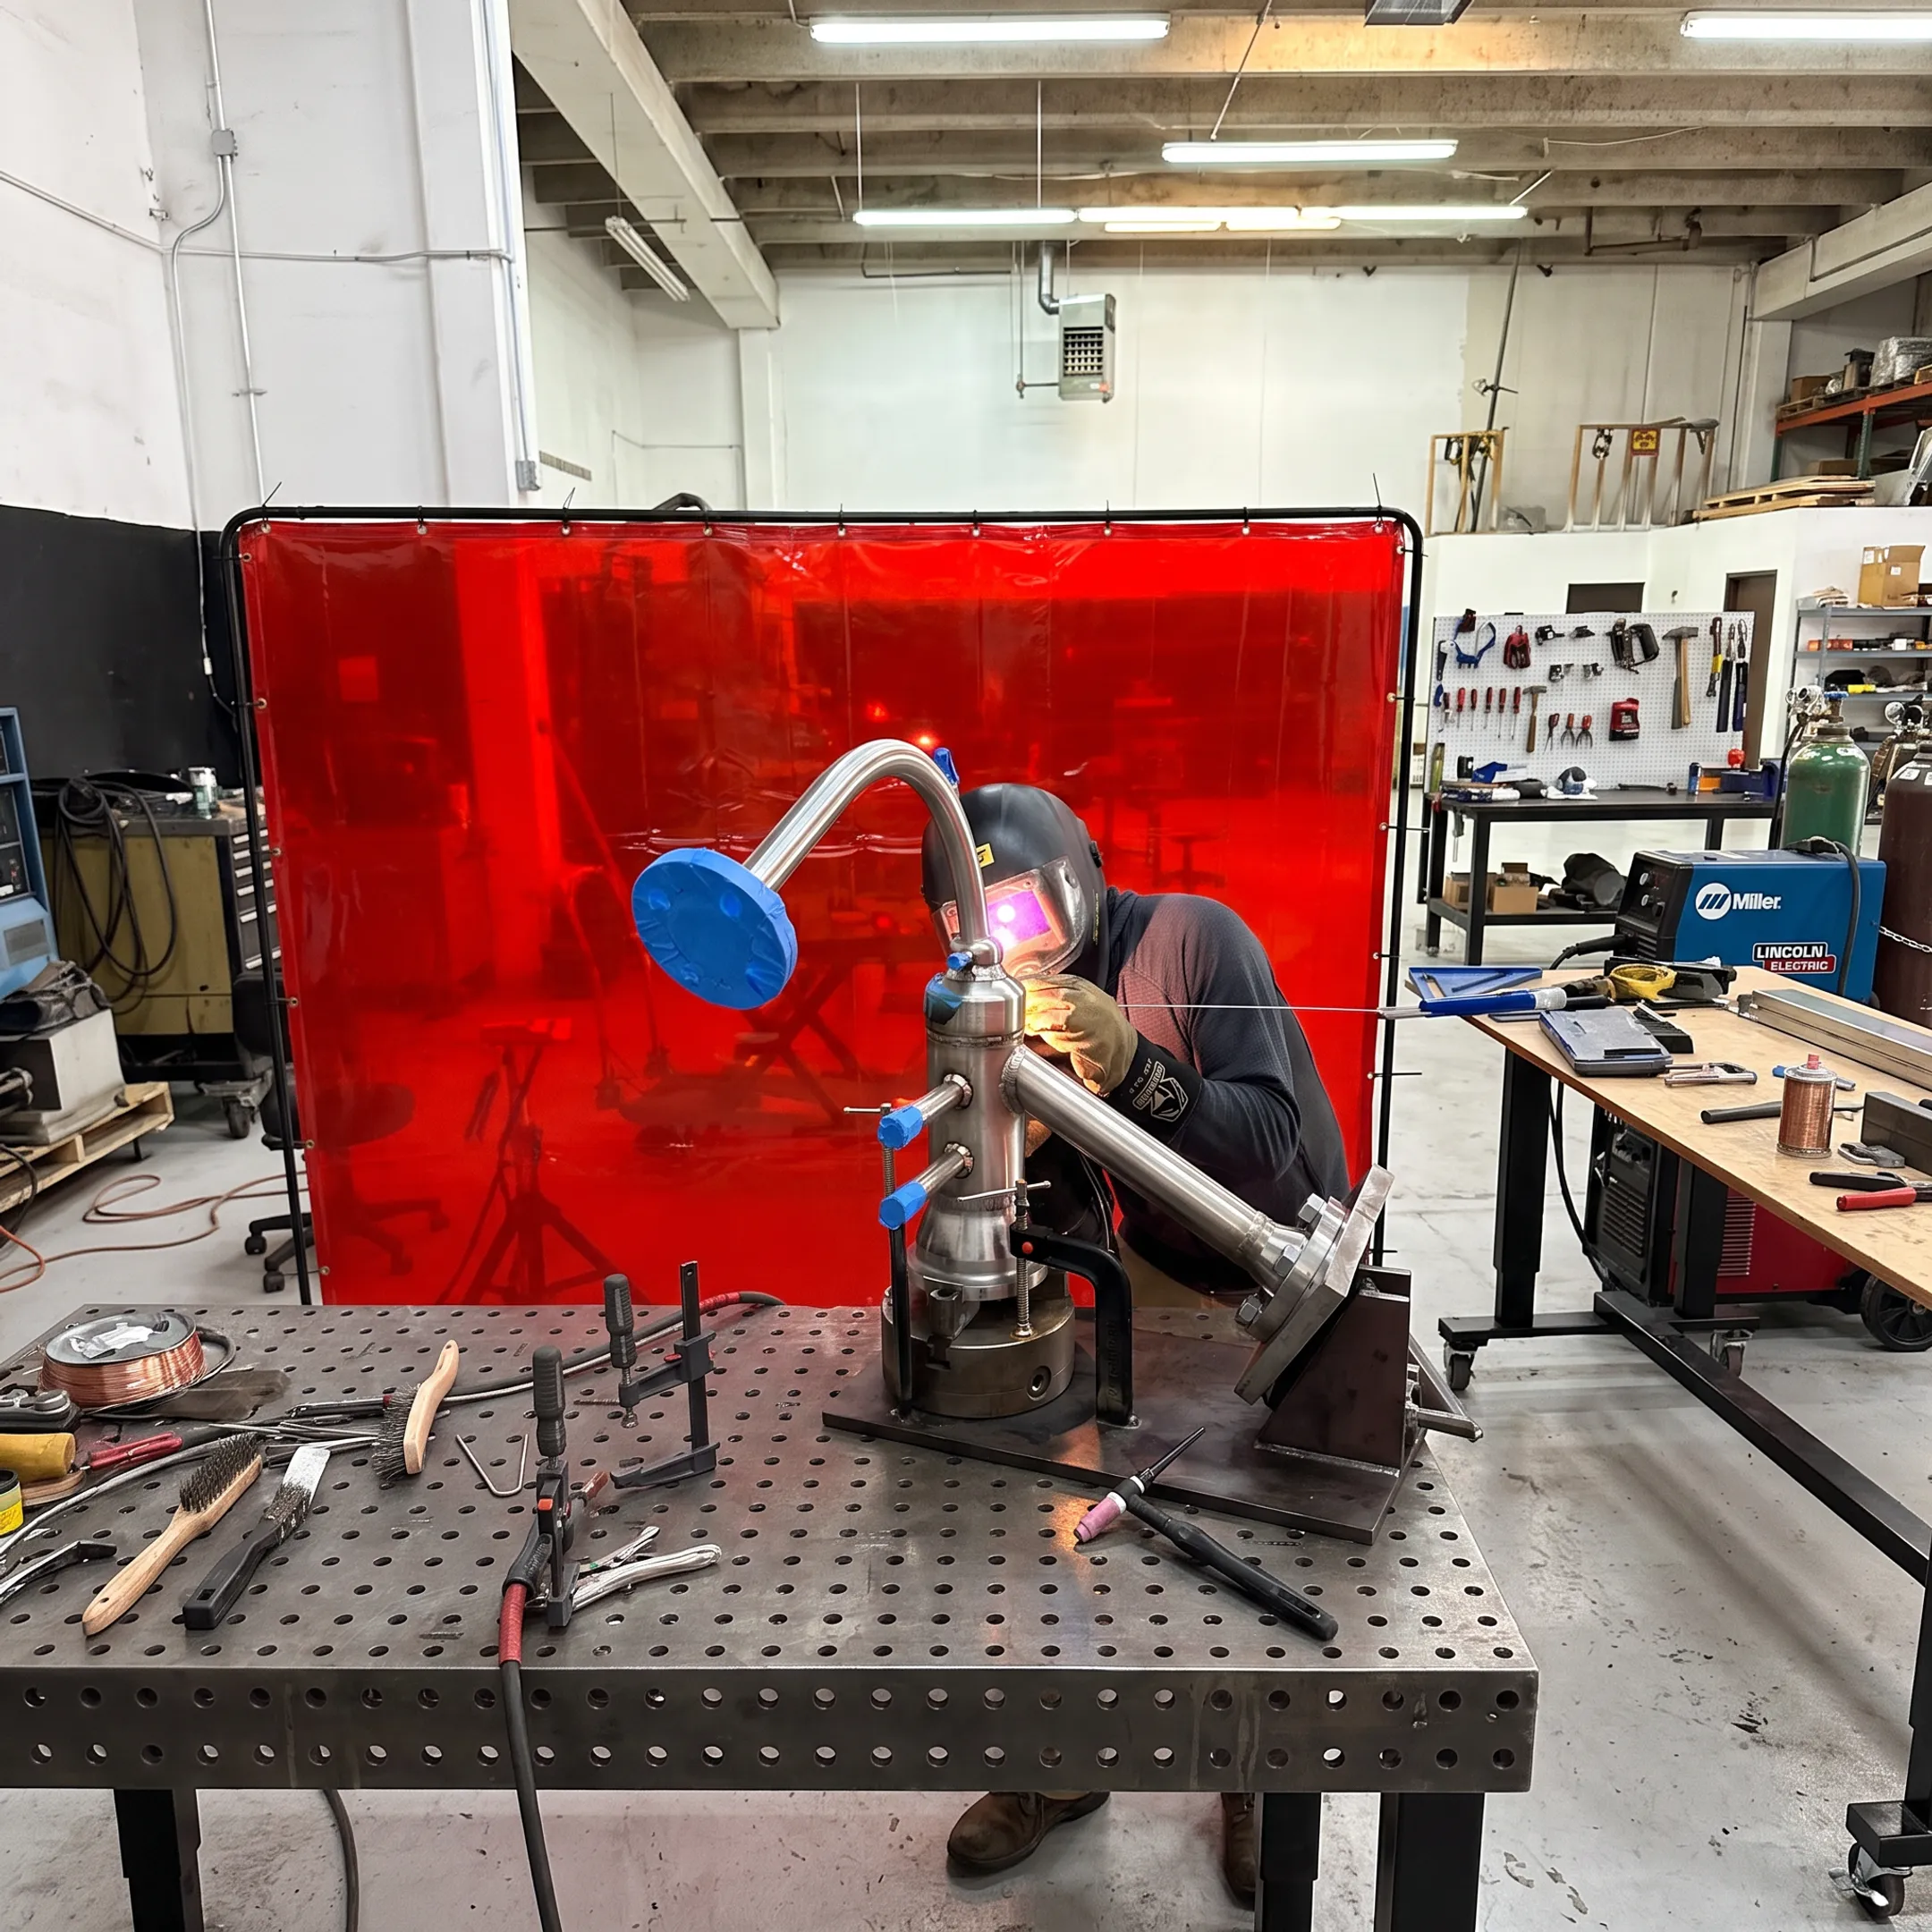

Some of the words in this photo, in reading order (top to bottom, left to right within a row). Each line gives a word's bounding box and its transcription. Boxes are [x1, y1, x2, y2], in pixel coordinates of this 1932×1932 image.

[1732, 894, 1781, 910] Miller
[1757, 945, 1824, 959] LINCOLN
[1770, 961, 1829, 971] ELECTRIC
